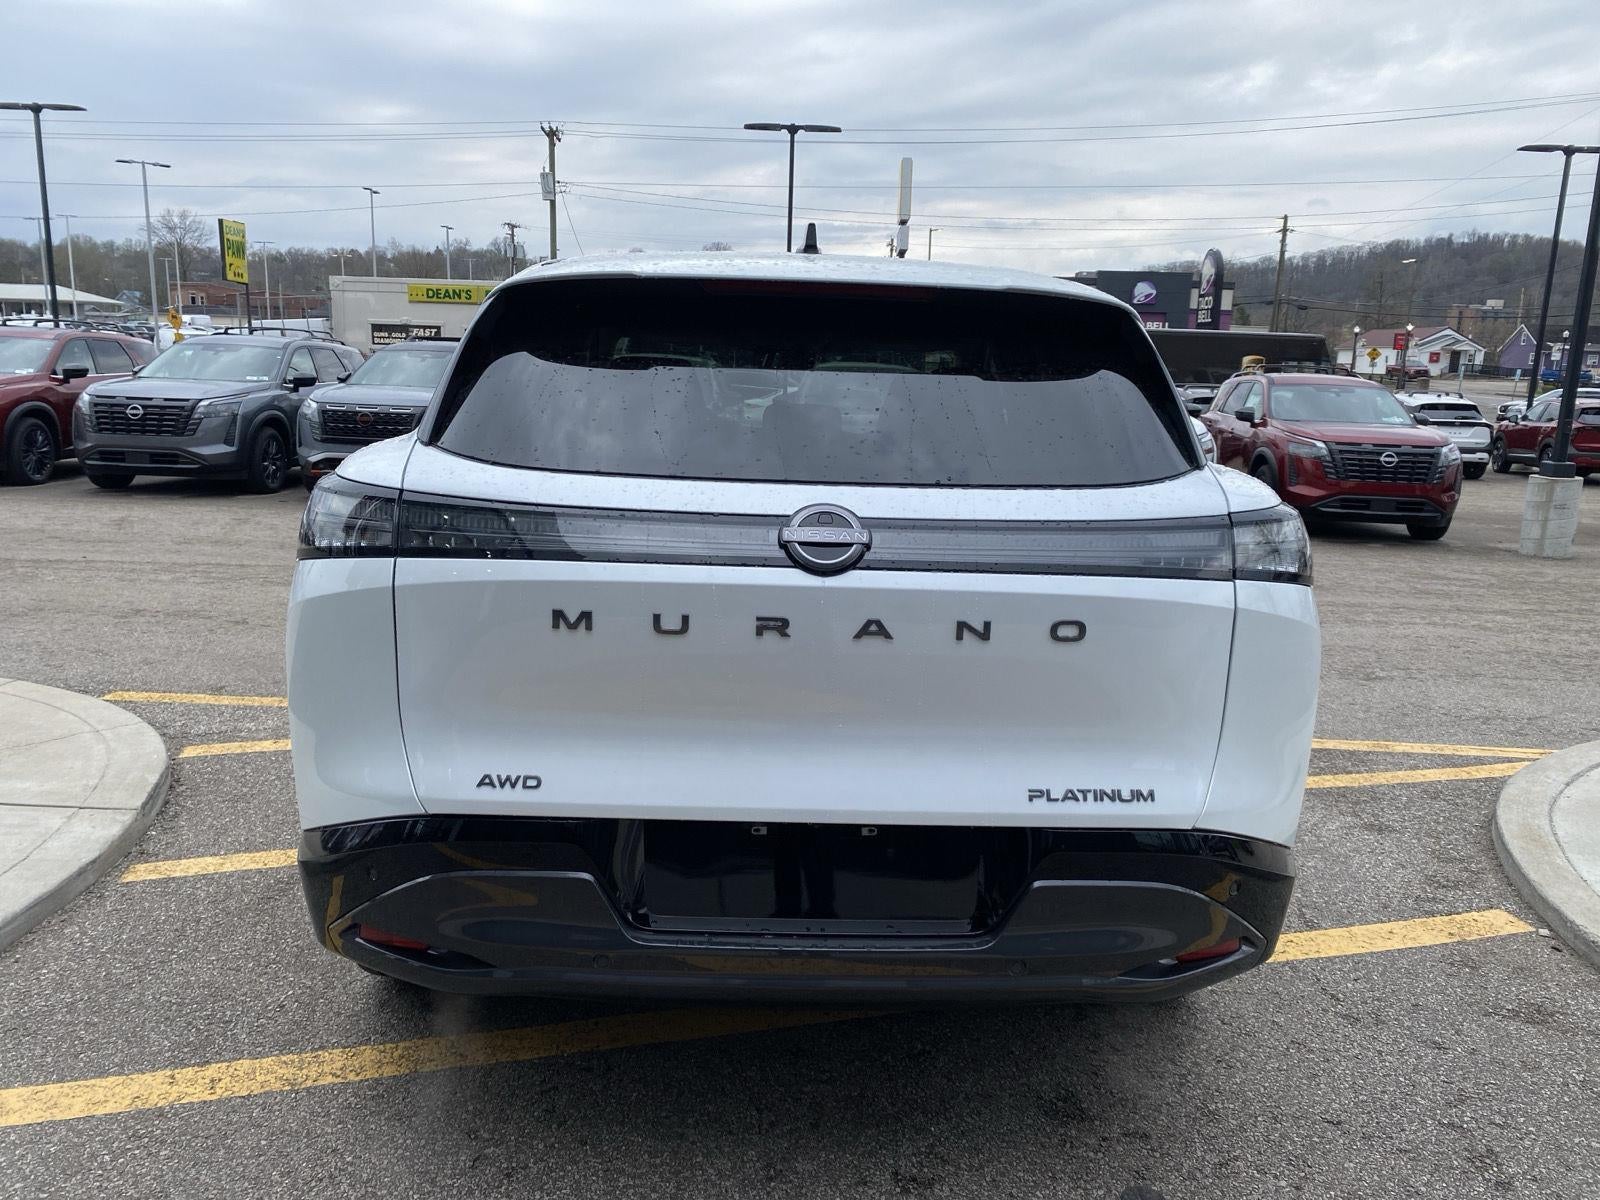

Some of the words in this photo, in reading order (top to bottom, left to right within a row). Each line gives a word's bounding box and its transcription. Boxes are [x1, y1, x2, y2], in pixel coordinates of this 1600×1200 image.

[226, 238, 246, 260] PAWN
[426, 288, 472, 300] DEAN'S
[1199, 296, 1213, 309] TACO
[1197, 310, 1212, 323] BELL
[412, 328, 437, 336] FAST
[784, 529, 867, 542] NISSAN
[552, 609, 1087, 642] MURANO
[476, 774, 542, 789] AWD
[1028, 789, 1155, 803] PLATINUM
